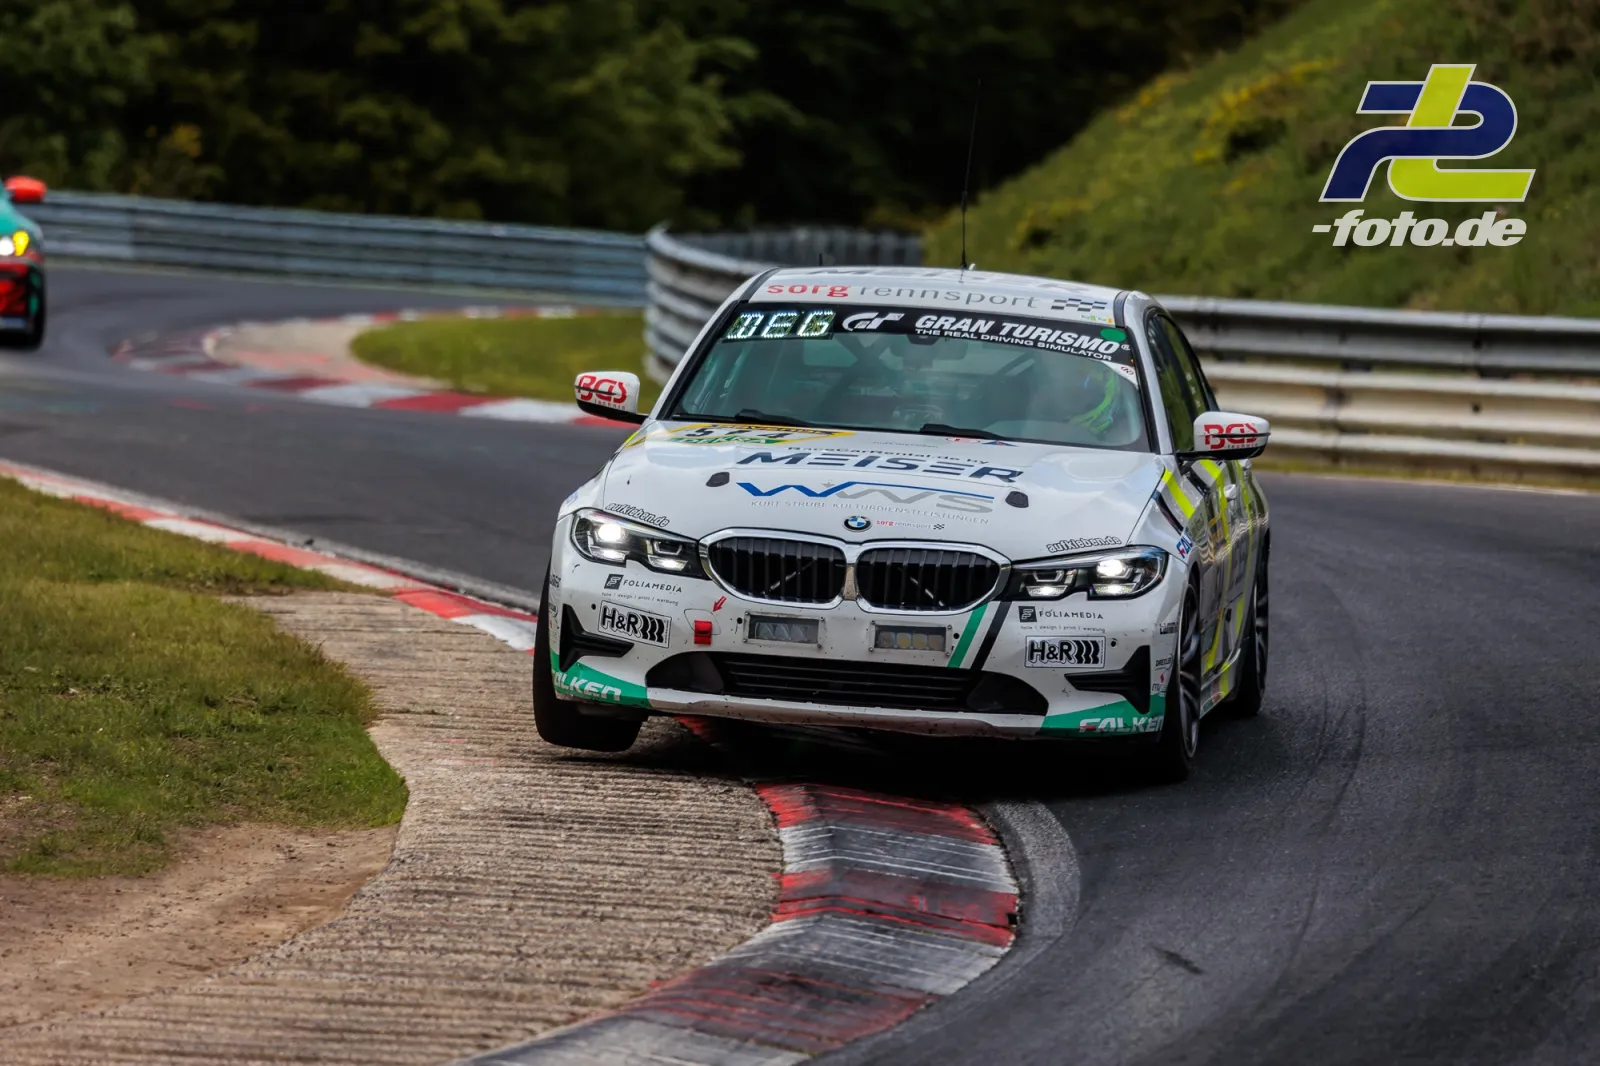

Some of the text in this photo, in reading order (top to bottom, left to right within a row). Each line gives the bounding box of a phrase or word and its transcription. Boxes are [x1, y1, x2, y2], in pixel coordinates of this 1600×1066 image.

[767, 283, 1039, 309] sorg rennsport
[915, 314, 996, 333] GRAN
[915, 328, 1112, 361] THE REAL DRIVING SIMULATOR
[577, 375, 628, 404] BGS
[1204, 422, 1258, 450] BGS
[736, 452, 1024, 483] MEISER
[605, 502, 670, 528] aufkleben.de
[894, 521, 932, 530] rennsport
[1046, 535, 1122, 554] aufkleben.de
[623, 579, 683, 593] FOLIAMEDIA
[601, 605, 639, 635] H&R
[1039, 610, 1104, 620] FOLIAMEDIA
[1028, 640, 1073, 662] H&R
[552, 669, 622, 702] ALKEN
